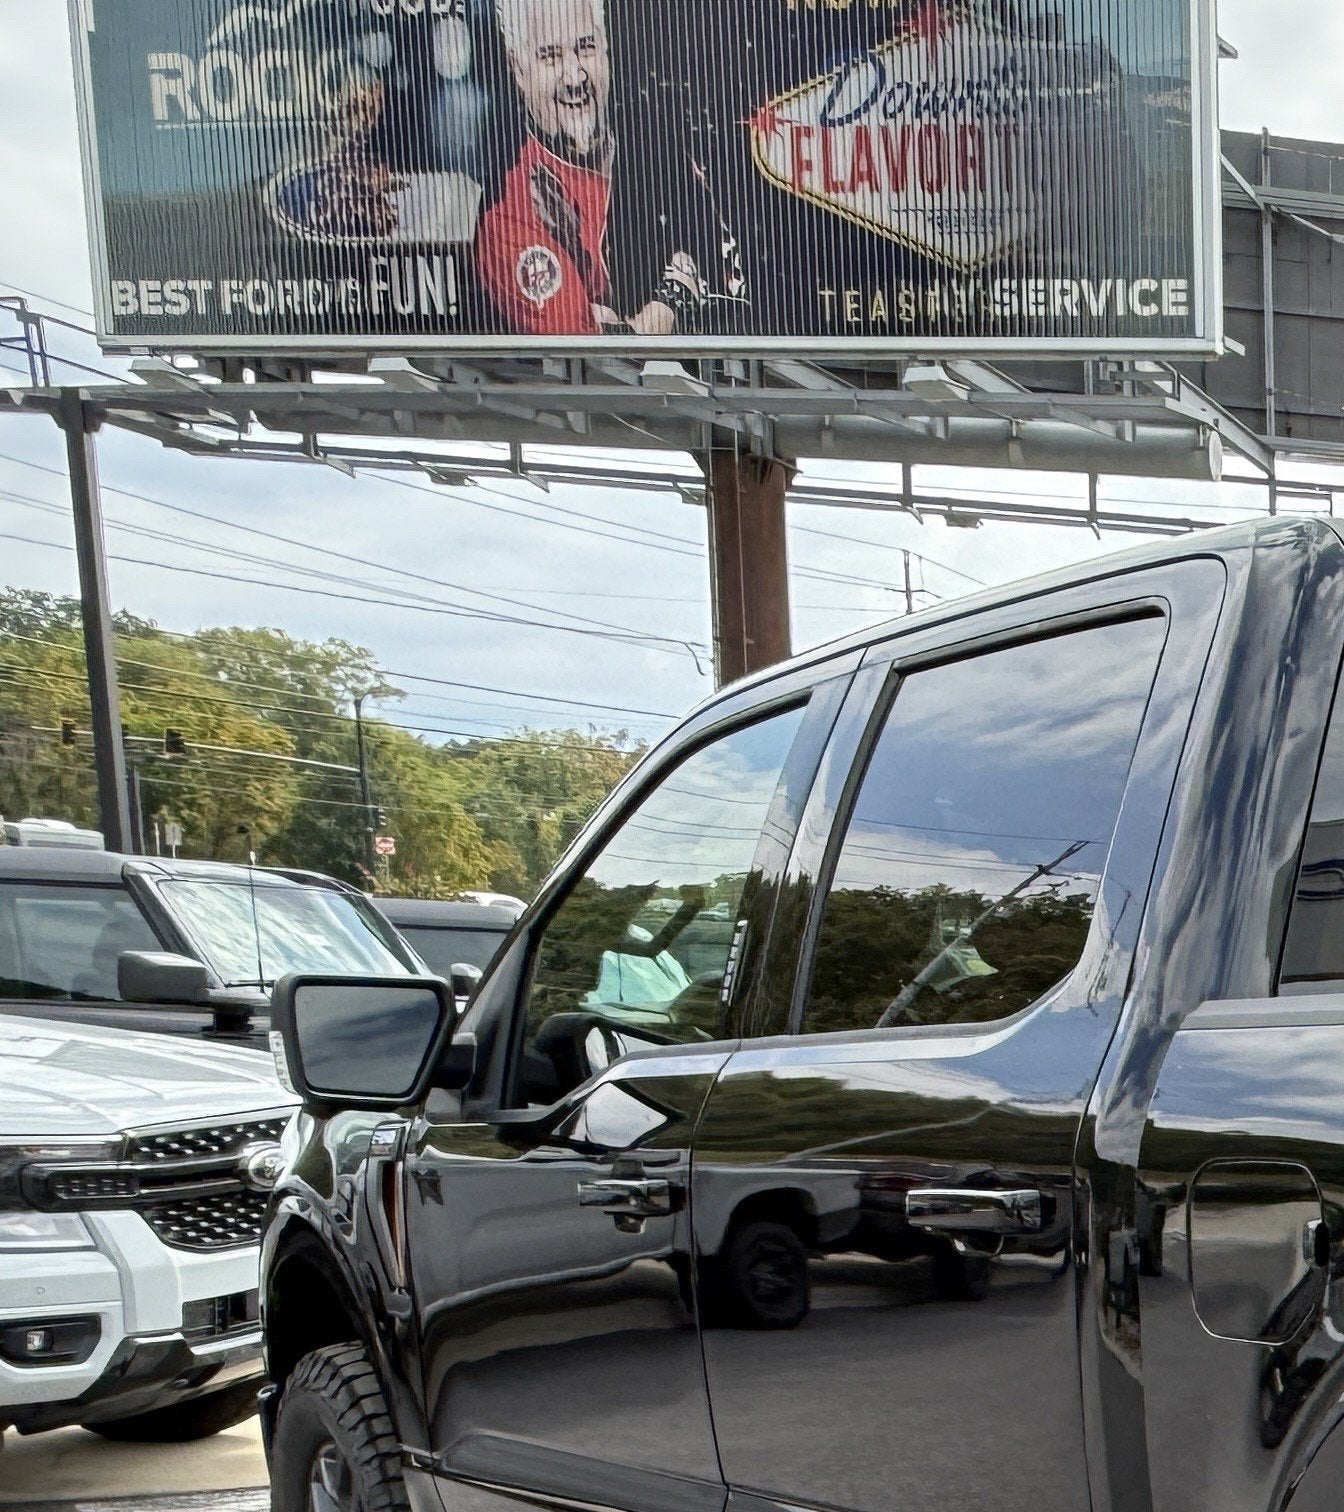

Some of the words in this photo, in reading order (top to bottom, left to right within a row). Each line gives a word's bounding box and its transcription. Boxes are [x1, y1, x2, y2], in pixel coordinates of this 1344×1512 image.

[112, 279, 212, 316] BEST
[371, 254, 458, 317] FUN!
[993, 278, 1190, 318] SERVICE
